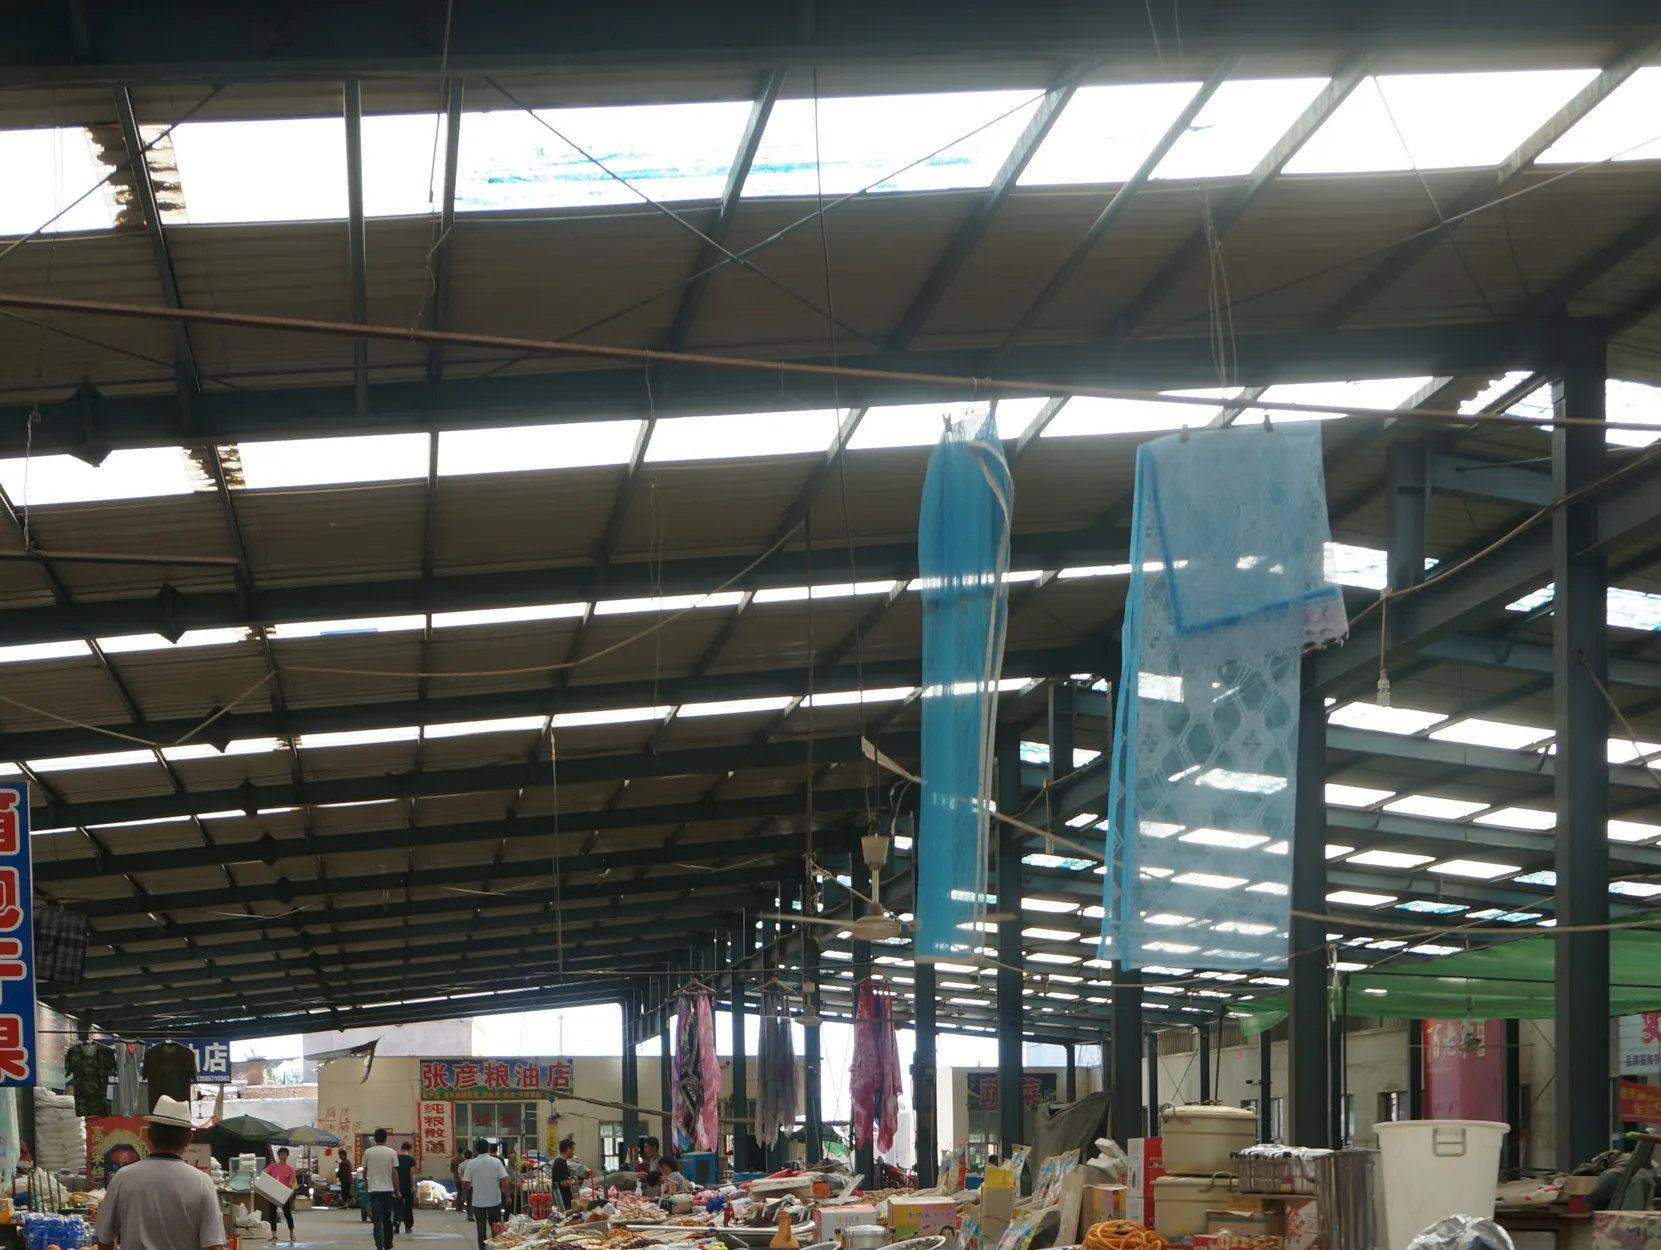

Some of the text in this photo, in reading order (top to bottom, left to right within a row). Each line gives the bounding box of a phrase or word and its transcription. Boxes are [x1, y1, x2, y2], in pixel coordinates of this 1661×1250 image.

[422, 1062, 571, 1089] 张彦粮油店
